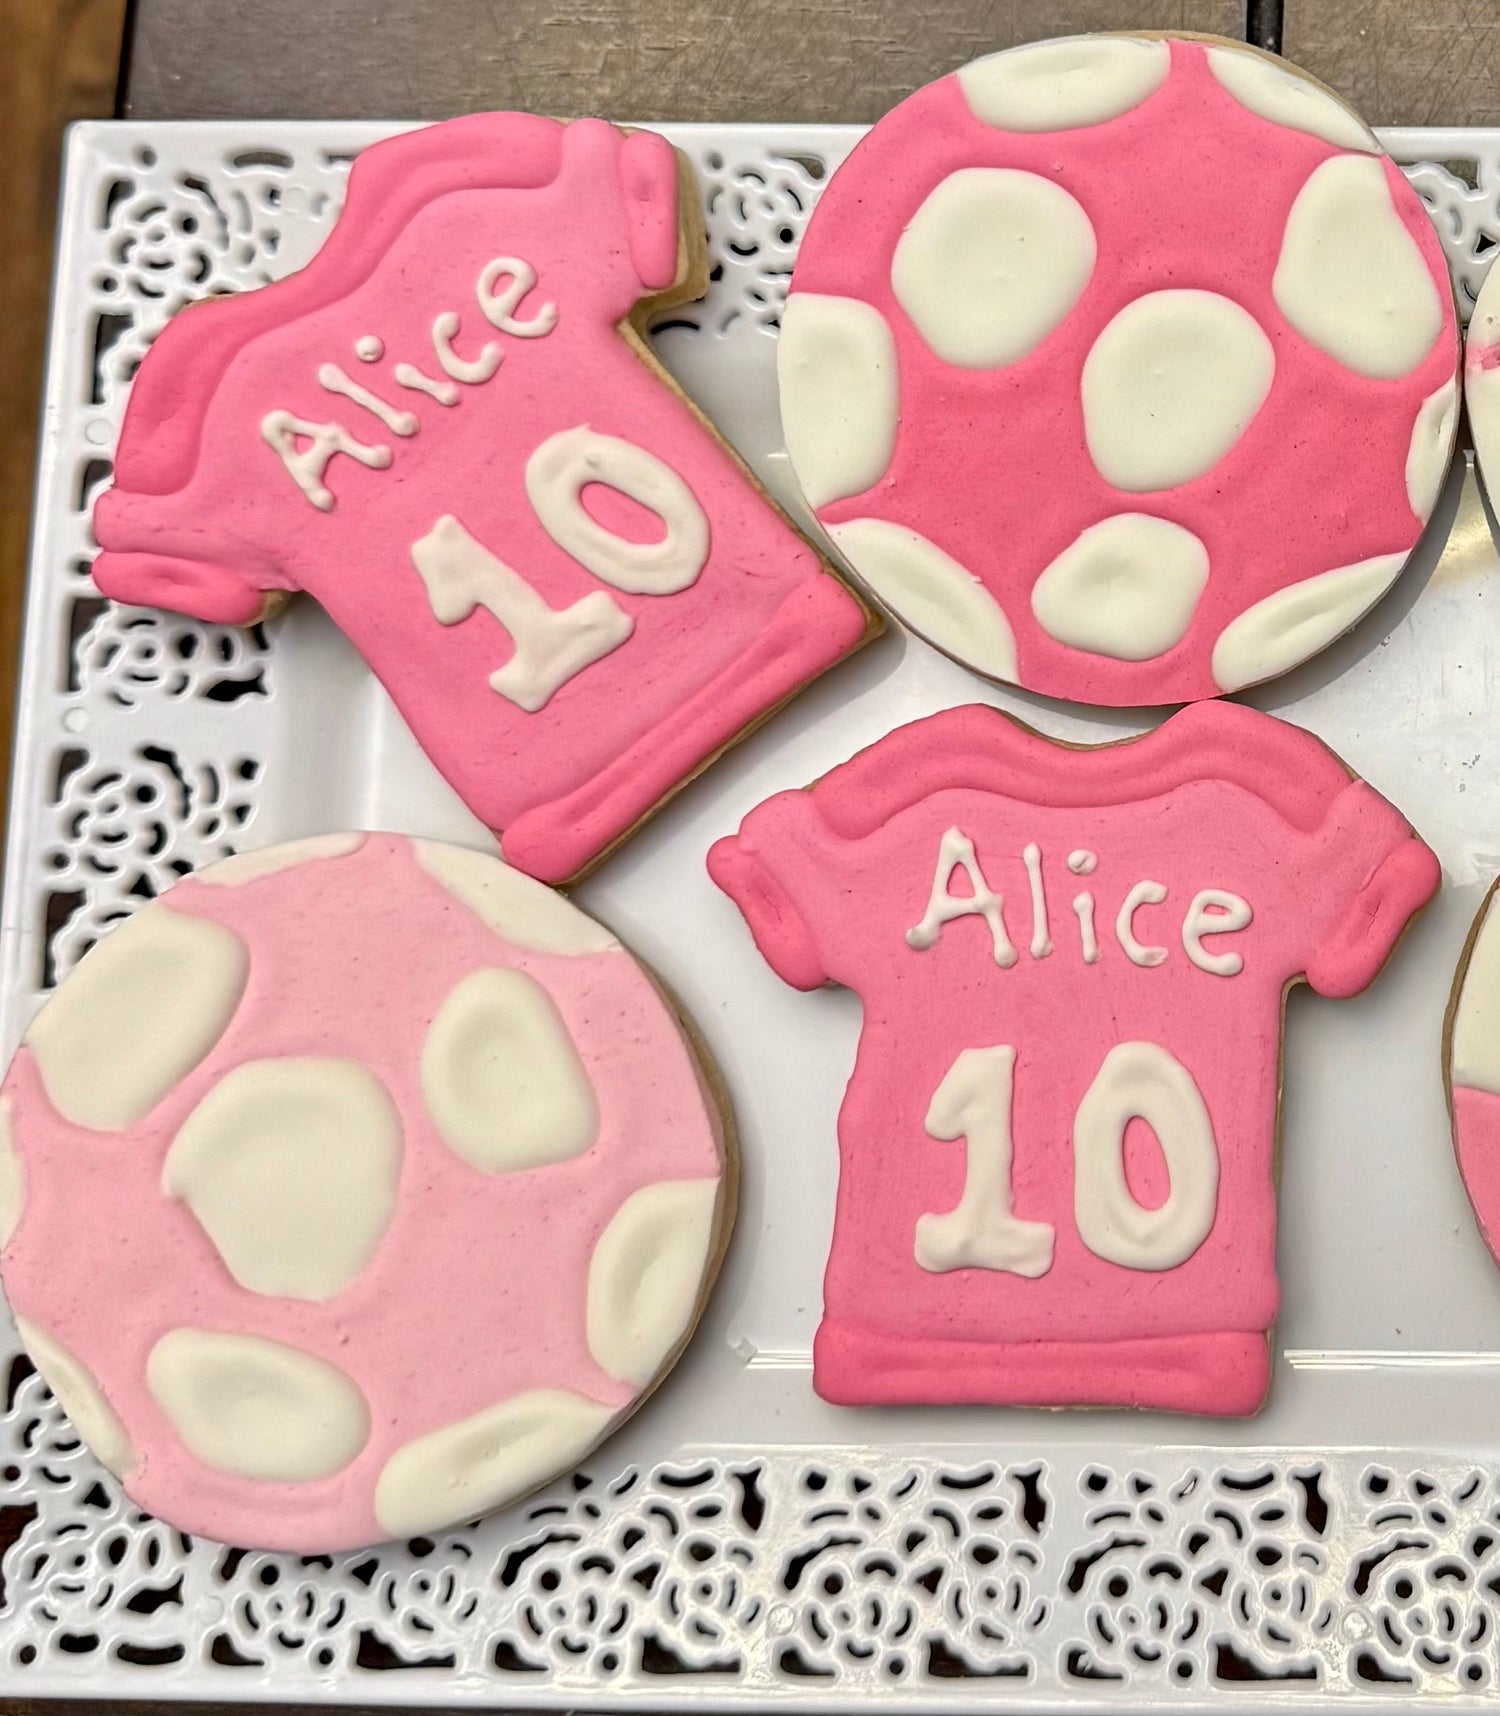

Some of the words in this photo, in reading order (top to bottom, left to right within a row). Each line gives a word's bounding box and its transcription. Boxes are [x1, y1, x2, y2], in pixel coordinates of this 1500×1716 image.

[261, 256, 557, 511] Alice
[411, 427, 709, 710] 10
[906, 827, 1252, 977] Alice
[915, 1040, 1218, 1278] 10
